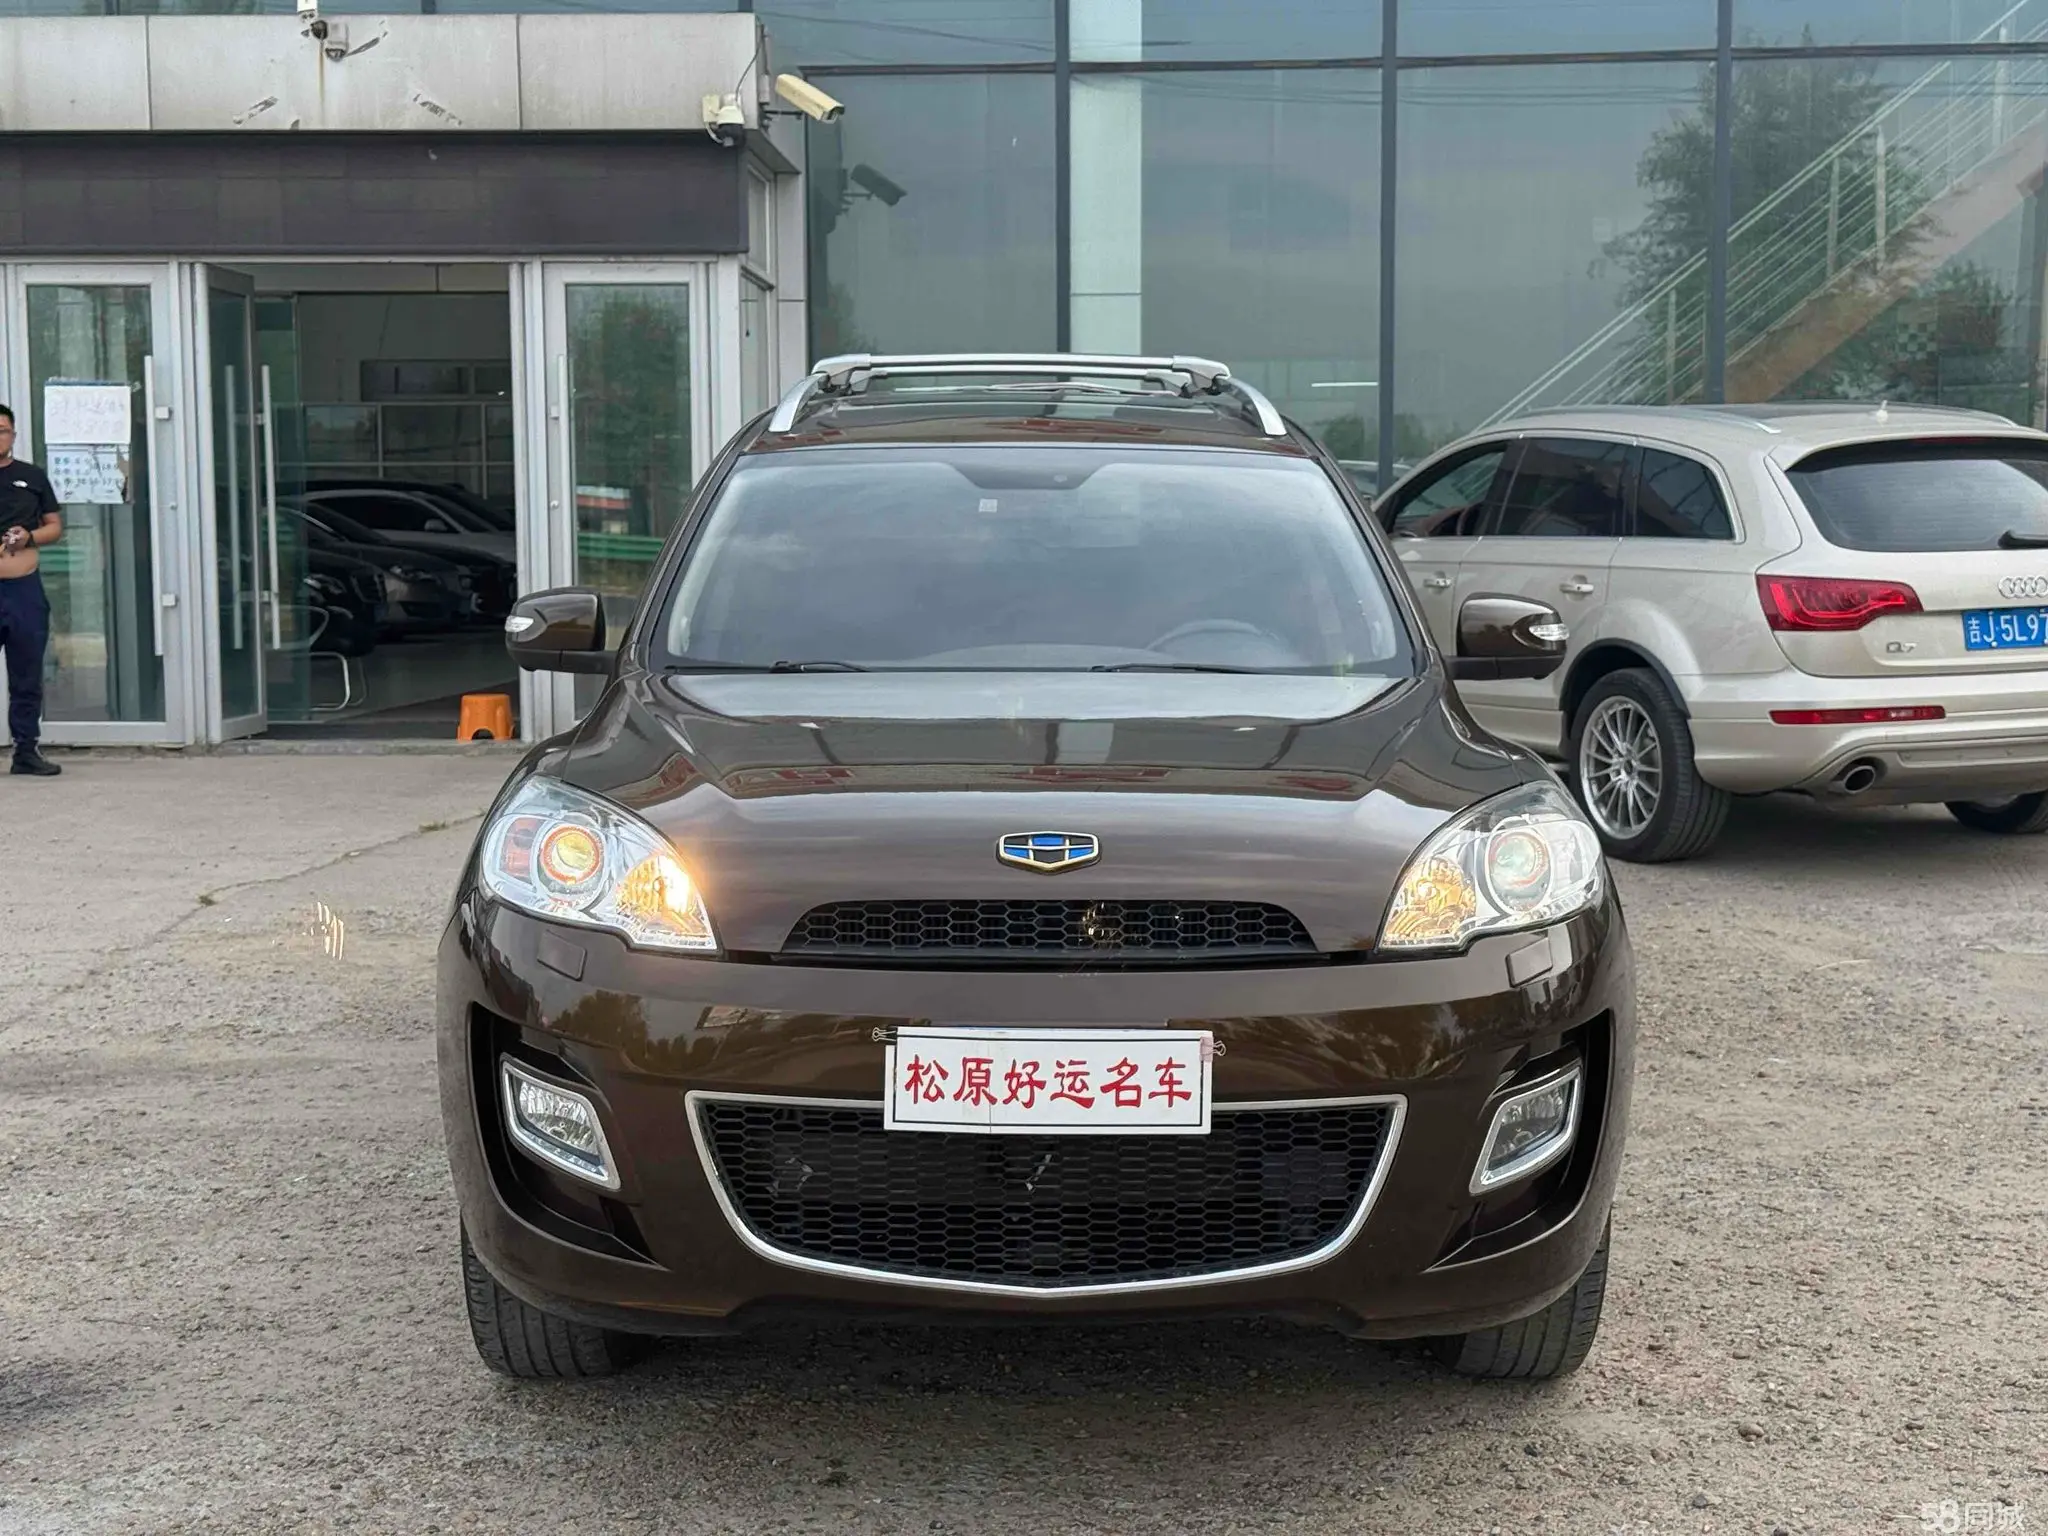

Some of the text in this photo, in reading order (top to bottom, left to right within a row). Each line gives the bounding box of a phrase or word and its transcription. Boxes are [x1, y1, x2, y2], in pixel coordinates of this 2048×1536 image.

[1886, 641, 1917, 654] Q7
[904, 1054, 1193, 1109] 松原好运名车
